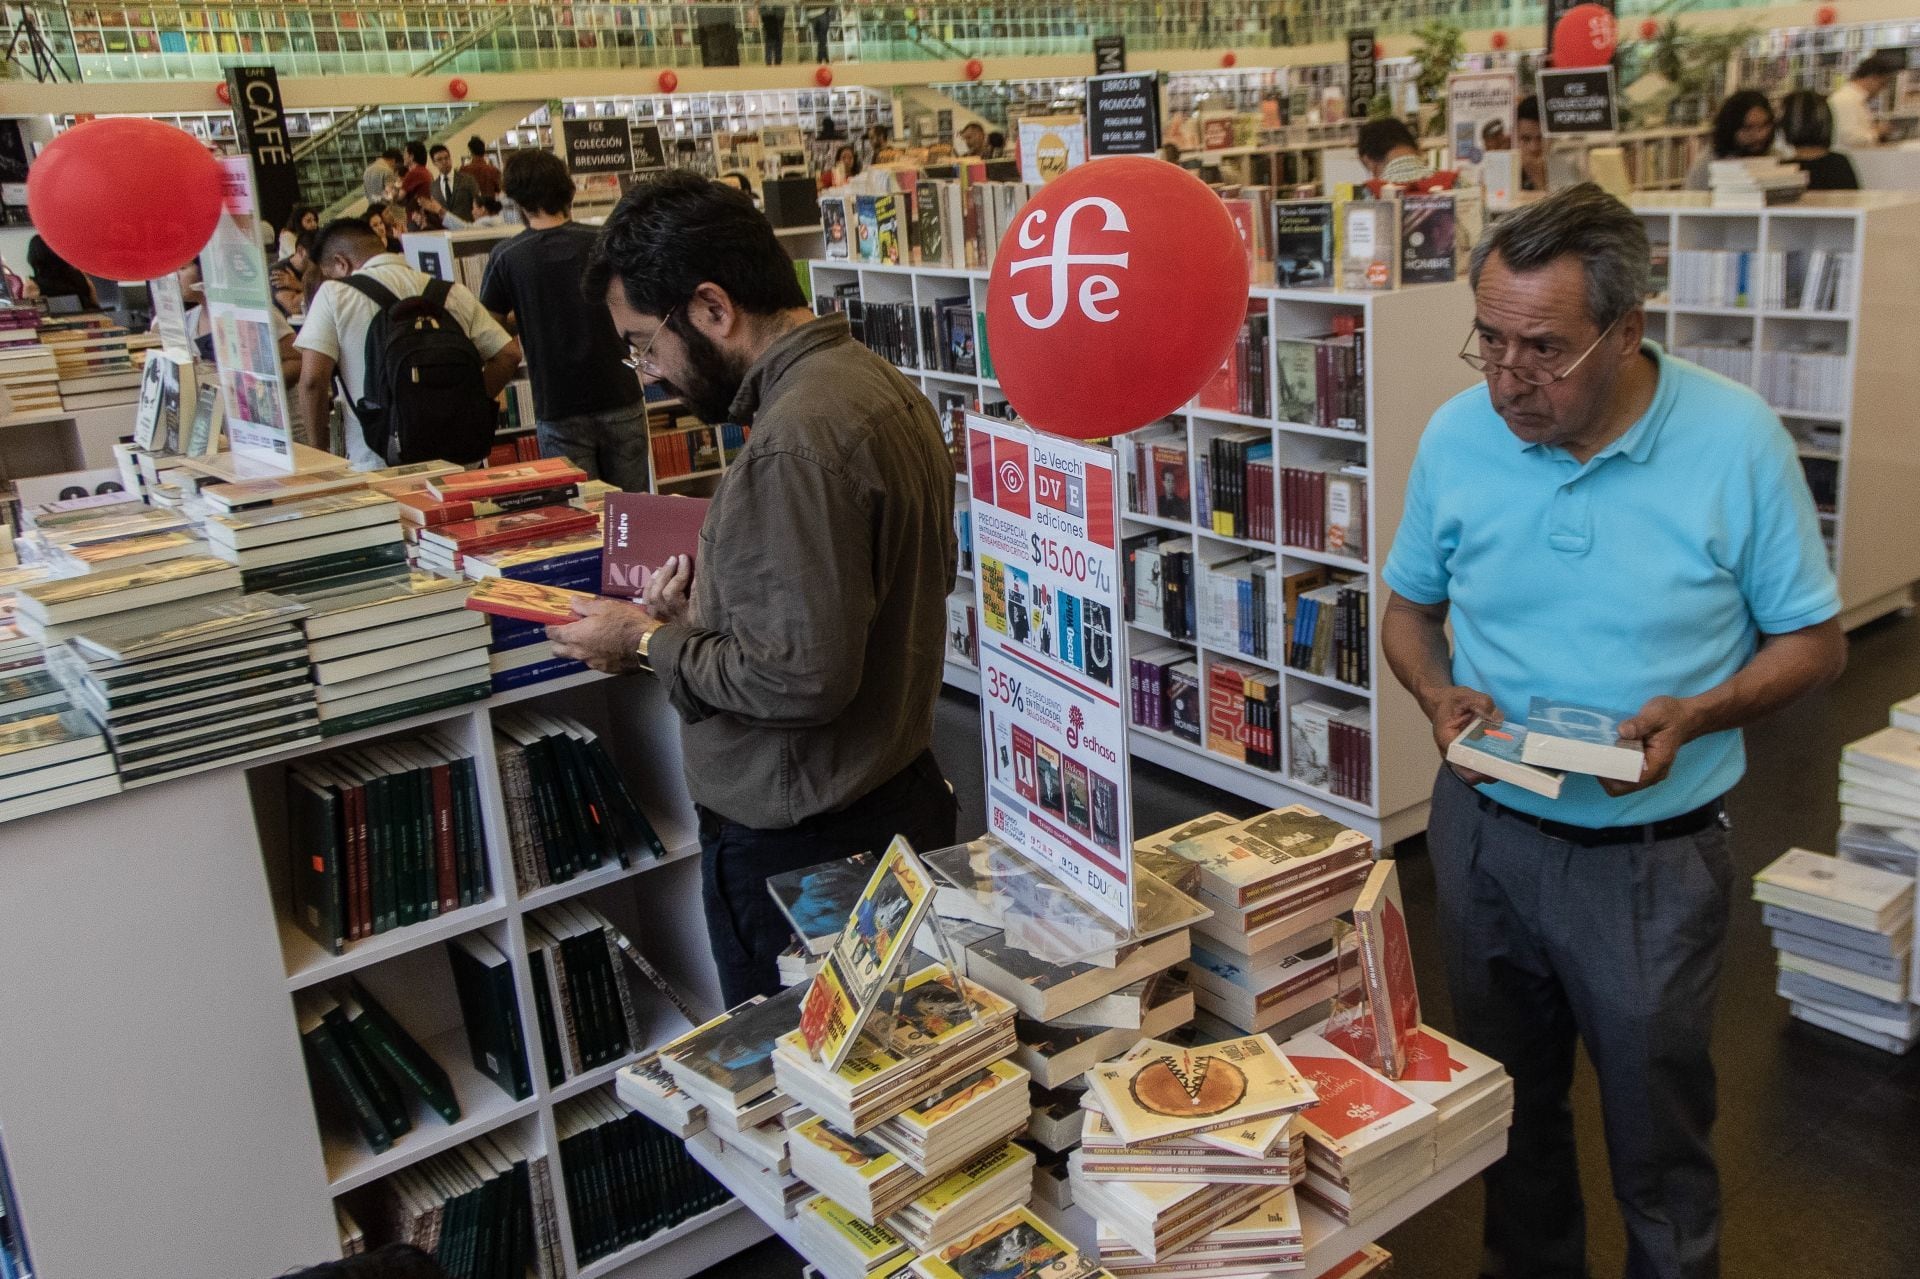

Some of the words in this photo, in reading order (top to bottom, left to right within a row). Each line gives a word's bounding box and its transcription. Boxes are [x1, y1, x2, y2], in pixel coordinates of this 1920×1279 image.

[245, 80, 291, 166] CAFÉ
[573, 135, 623, 150] COLECCIÓN
[575, 153, 626, 167] BREVIARIOS
[1033, 447, 1048, 465] De
[1049, 452, 1083, 475] Vecchi
[617, 512, 628, 549] Fedro
[978, 512, 1000, 530] PRECIO
[1000, 519, 1029, 541] ESPECIAL
[1036, 508, 1084, 539] ediciones
[1031, 531, 1086, 583] $15.00
[987, 666, 1024, 713] 35%
[1082, 735, 1117, 764] edhasa
[1003, 812, 1018, 826] FONDO
